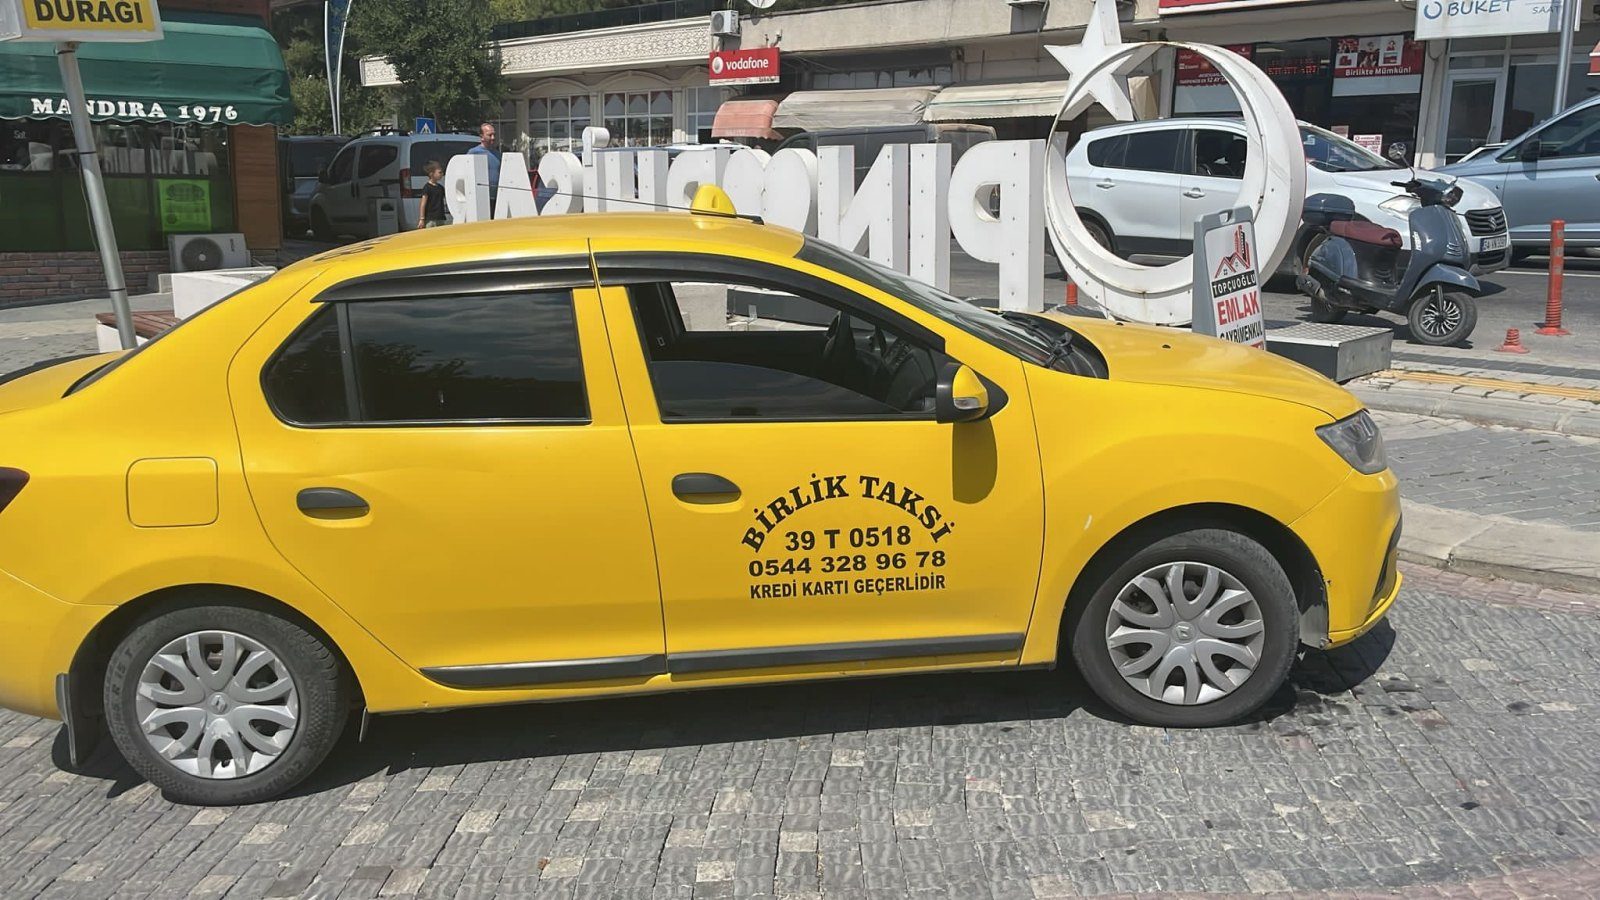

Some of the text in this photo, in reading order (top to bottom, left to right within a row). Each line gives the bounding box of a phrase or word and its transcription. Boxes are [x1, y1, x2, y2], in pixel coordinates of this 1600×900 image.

[1447, 0, 1515, 17] BUKET
[726, 57, 769, 71] vodafone
[1345, 66, 1411, 76] Birlikte Mümkün!
[178, 105, 238, 122] 1976
[1212, 273, 1256, 296] TOPÇUOĞLU
[1217, 291, 1260, 325] EMLAK
[741, 472, 955, 553] BİRLİK TAKSİ
[784, 525, 911, 551] 39 T 0518
[748, 550, 946, 577] 0544 328 96 78
[750, 571, 945, 599] KREDİ KARTI GEÇERLİDİR
